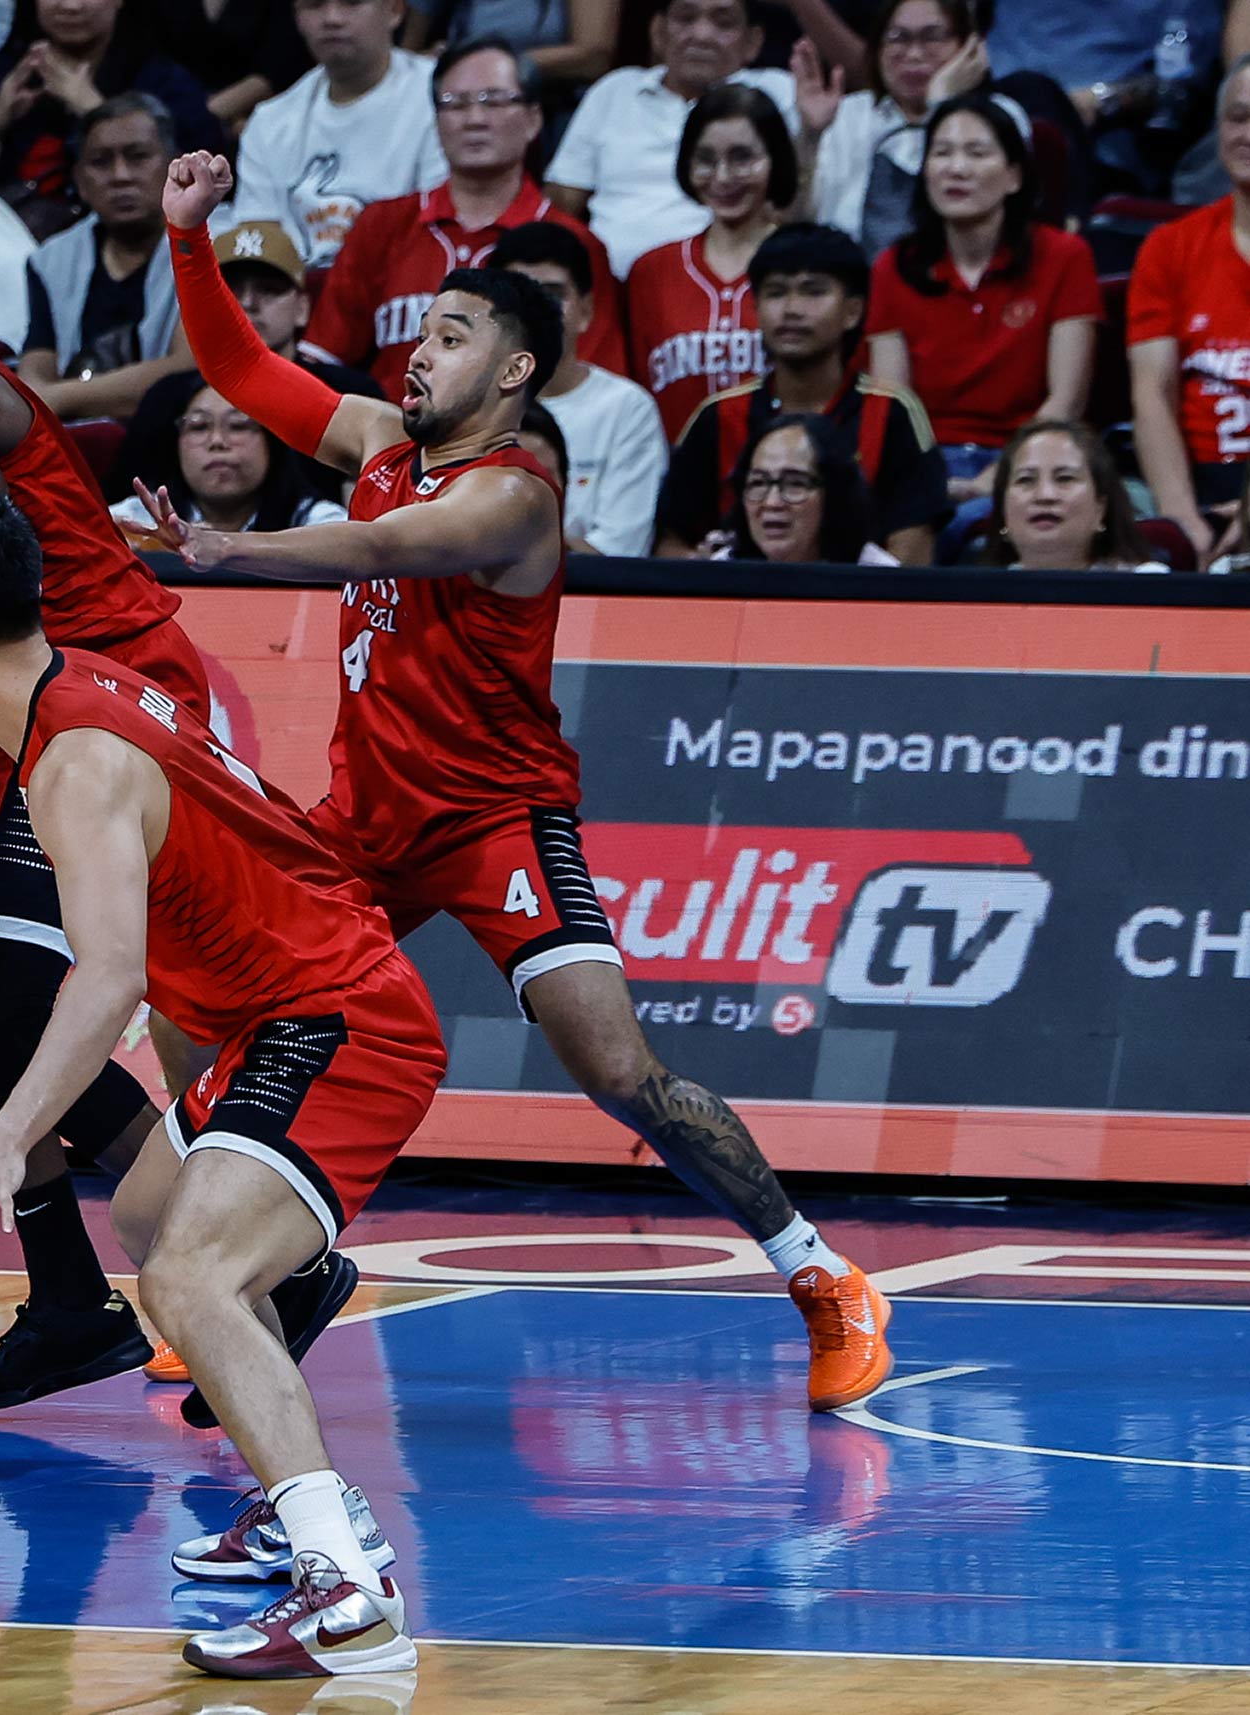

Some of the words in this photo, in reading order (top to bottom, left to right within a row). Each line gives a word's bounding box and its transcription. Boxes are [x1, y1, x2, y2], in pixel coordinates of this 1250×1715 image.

[342, 629, 374, 693] 4
[664, 717, 1122, 783] Mapapanood
[1139, 724, 1250, 779] din
[503, 868, 540, 918] 4
[865, 885, 1020, 987] tv
[1114, 906, 1250, 979] CH
[711, 996, 761, 1031] by
